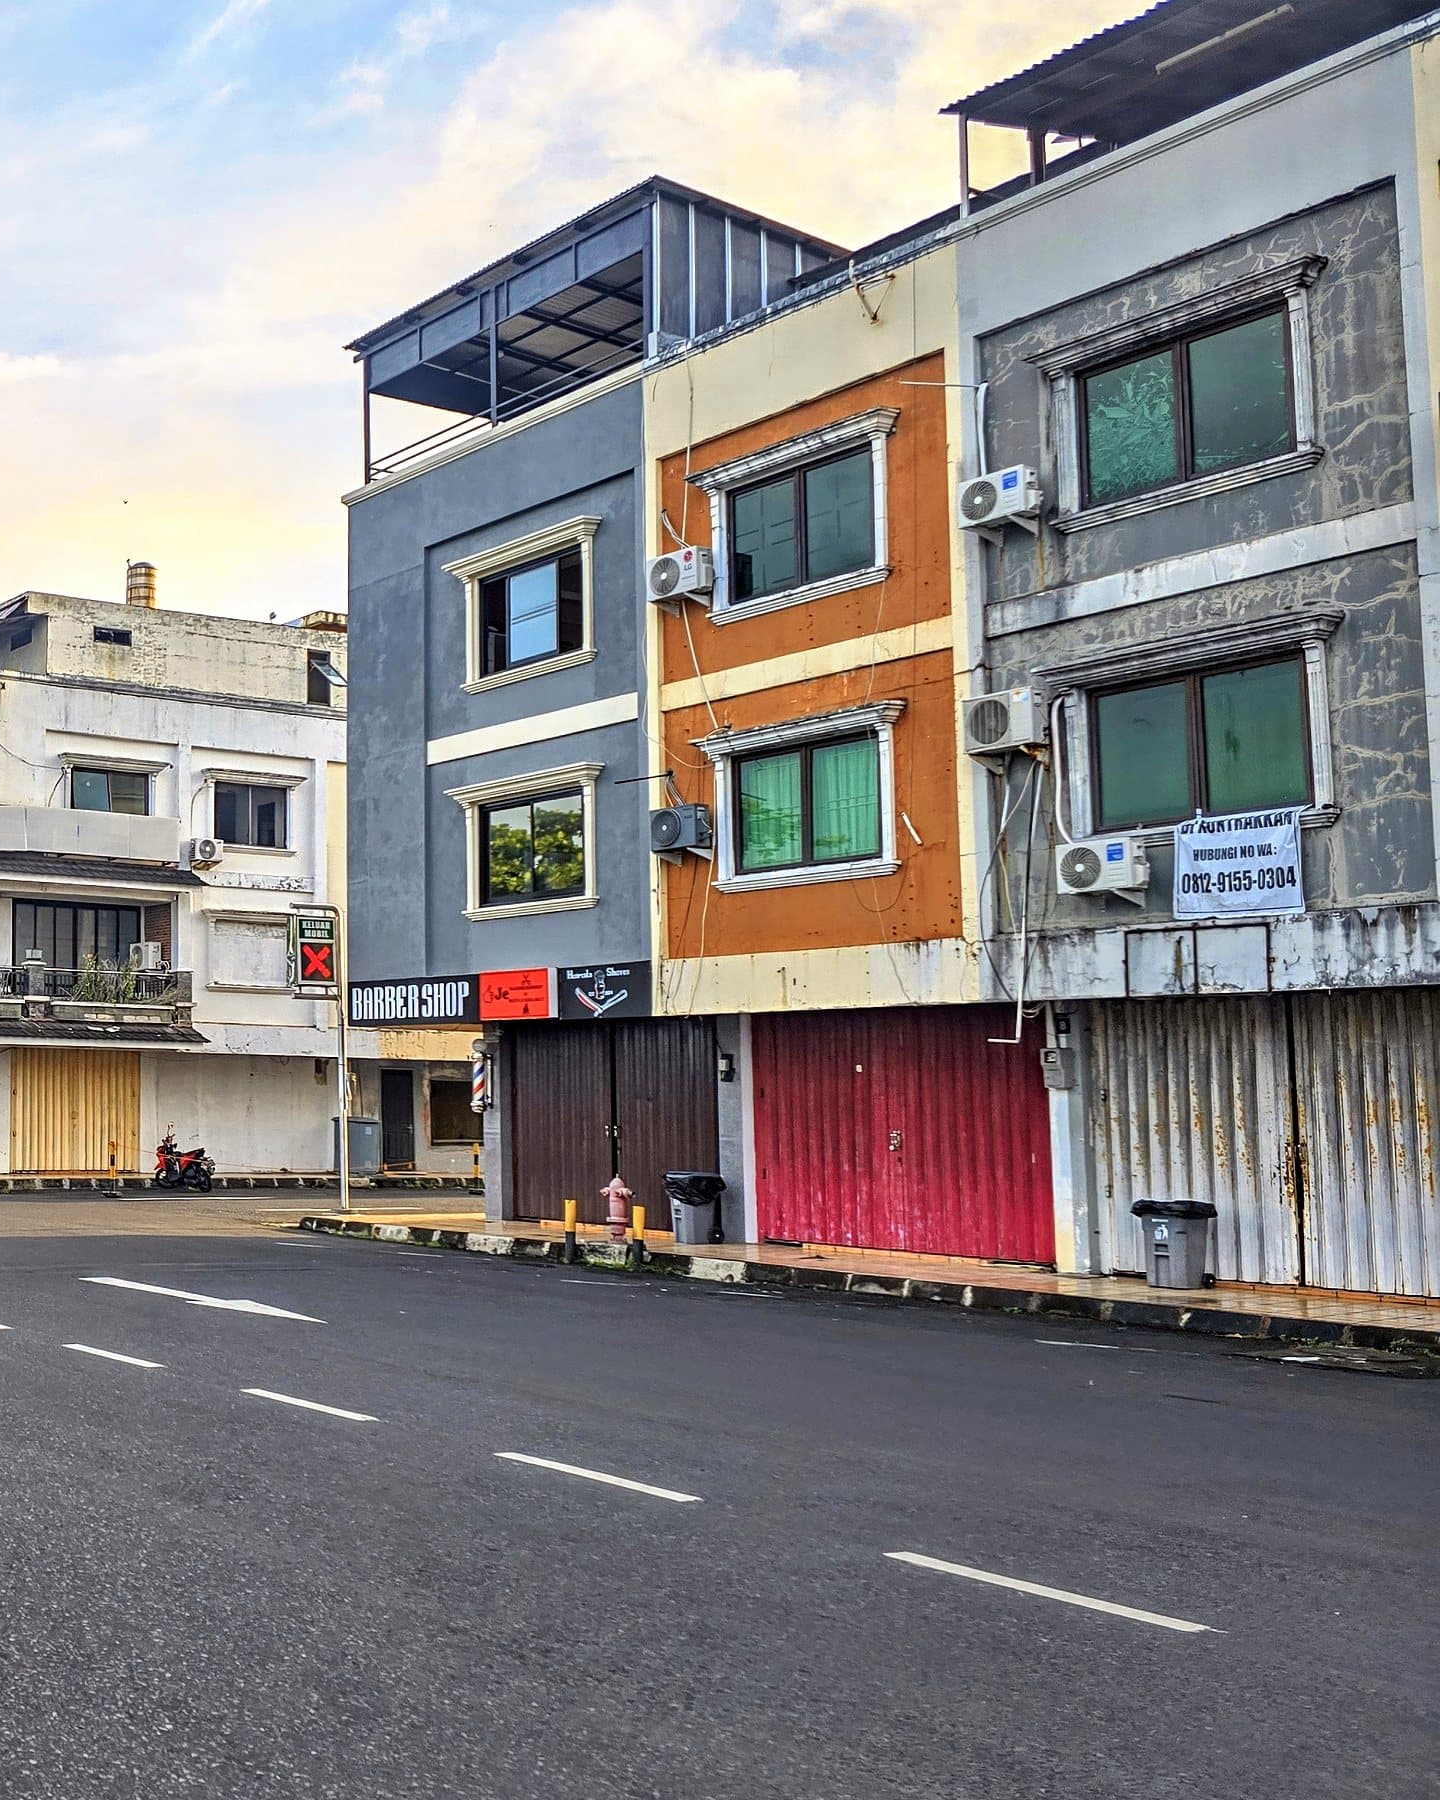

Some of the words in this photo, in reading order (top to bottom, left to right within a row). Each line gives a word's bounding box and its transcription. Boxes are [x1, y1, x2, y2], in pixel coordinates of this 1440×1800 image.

[684, 563, 693, 571] LG
[1193, 846, 1237, 861] HUBUNGI
[1240, 845, 1254, 858] NO
[1182, 866, 1296, 893] 0812-9155-0304
[302, 921, 330, 929] KELUAR
[304, 929, 329, 938] MOBIL
[352, 985, 419, 1020] BARBER
[421, 982, 469, 1017] SHOP
